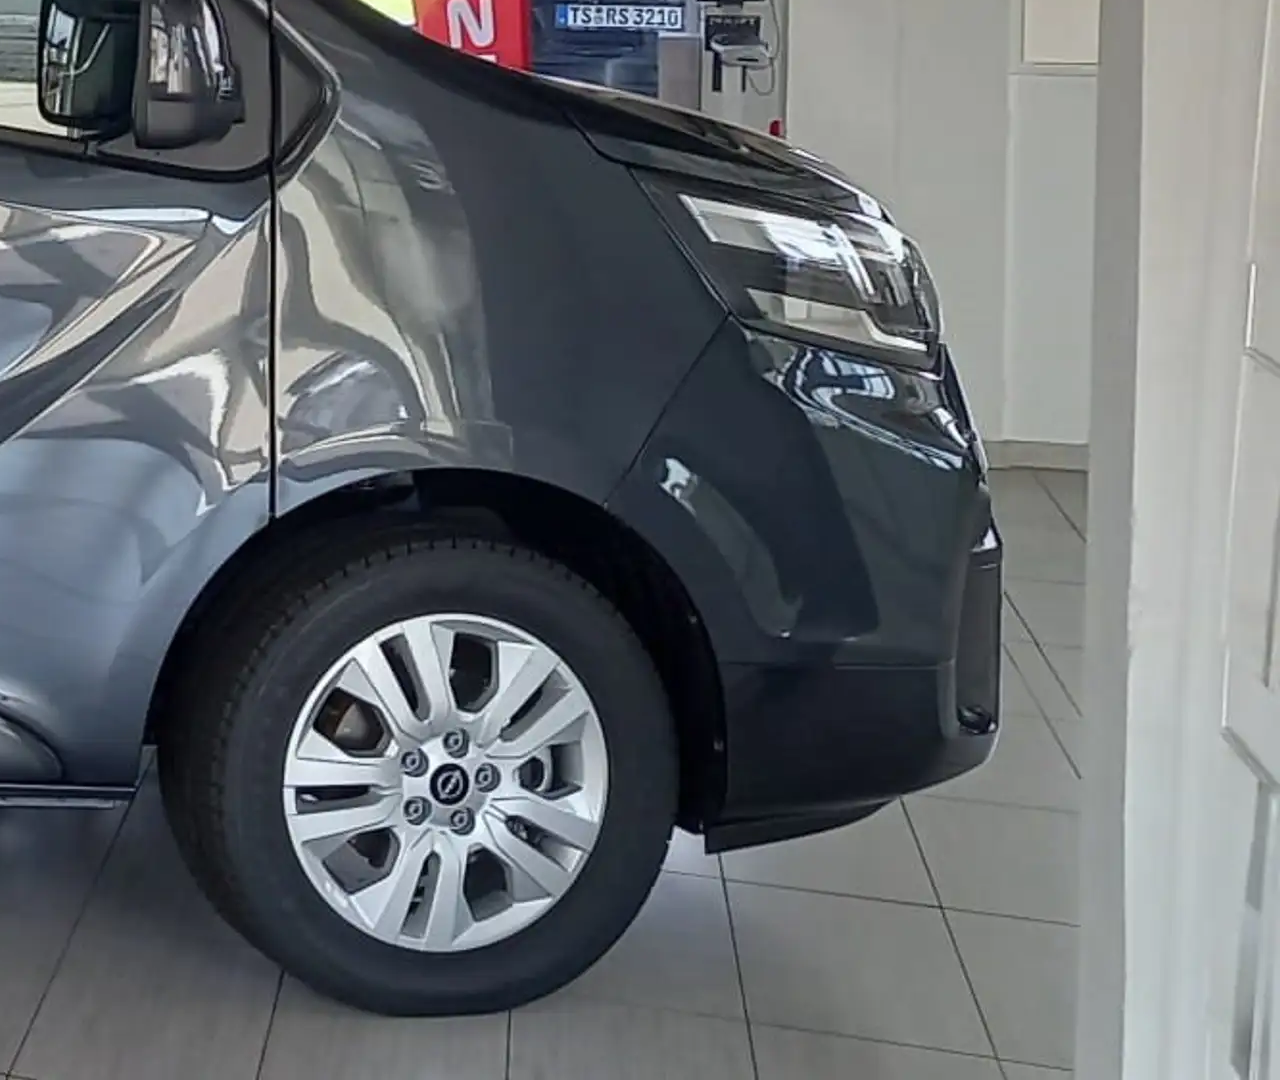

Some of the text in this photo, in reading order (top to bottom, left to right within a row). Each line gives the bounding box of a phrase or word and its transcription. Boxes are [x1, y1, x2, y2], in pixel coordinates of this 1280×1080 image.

[569, 6, 679, 28] TS RS 3210
